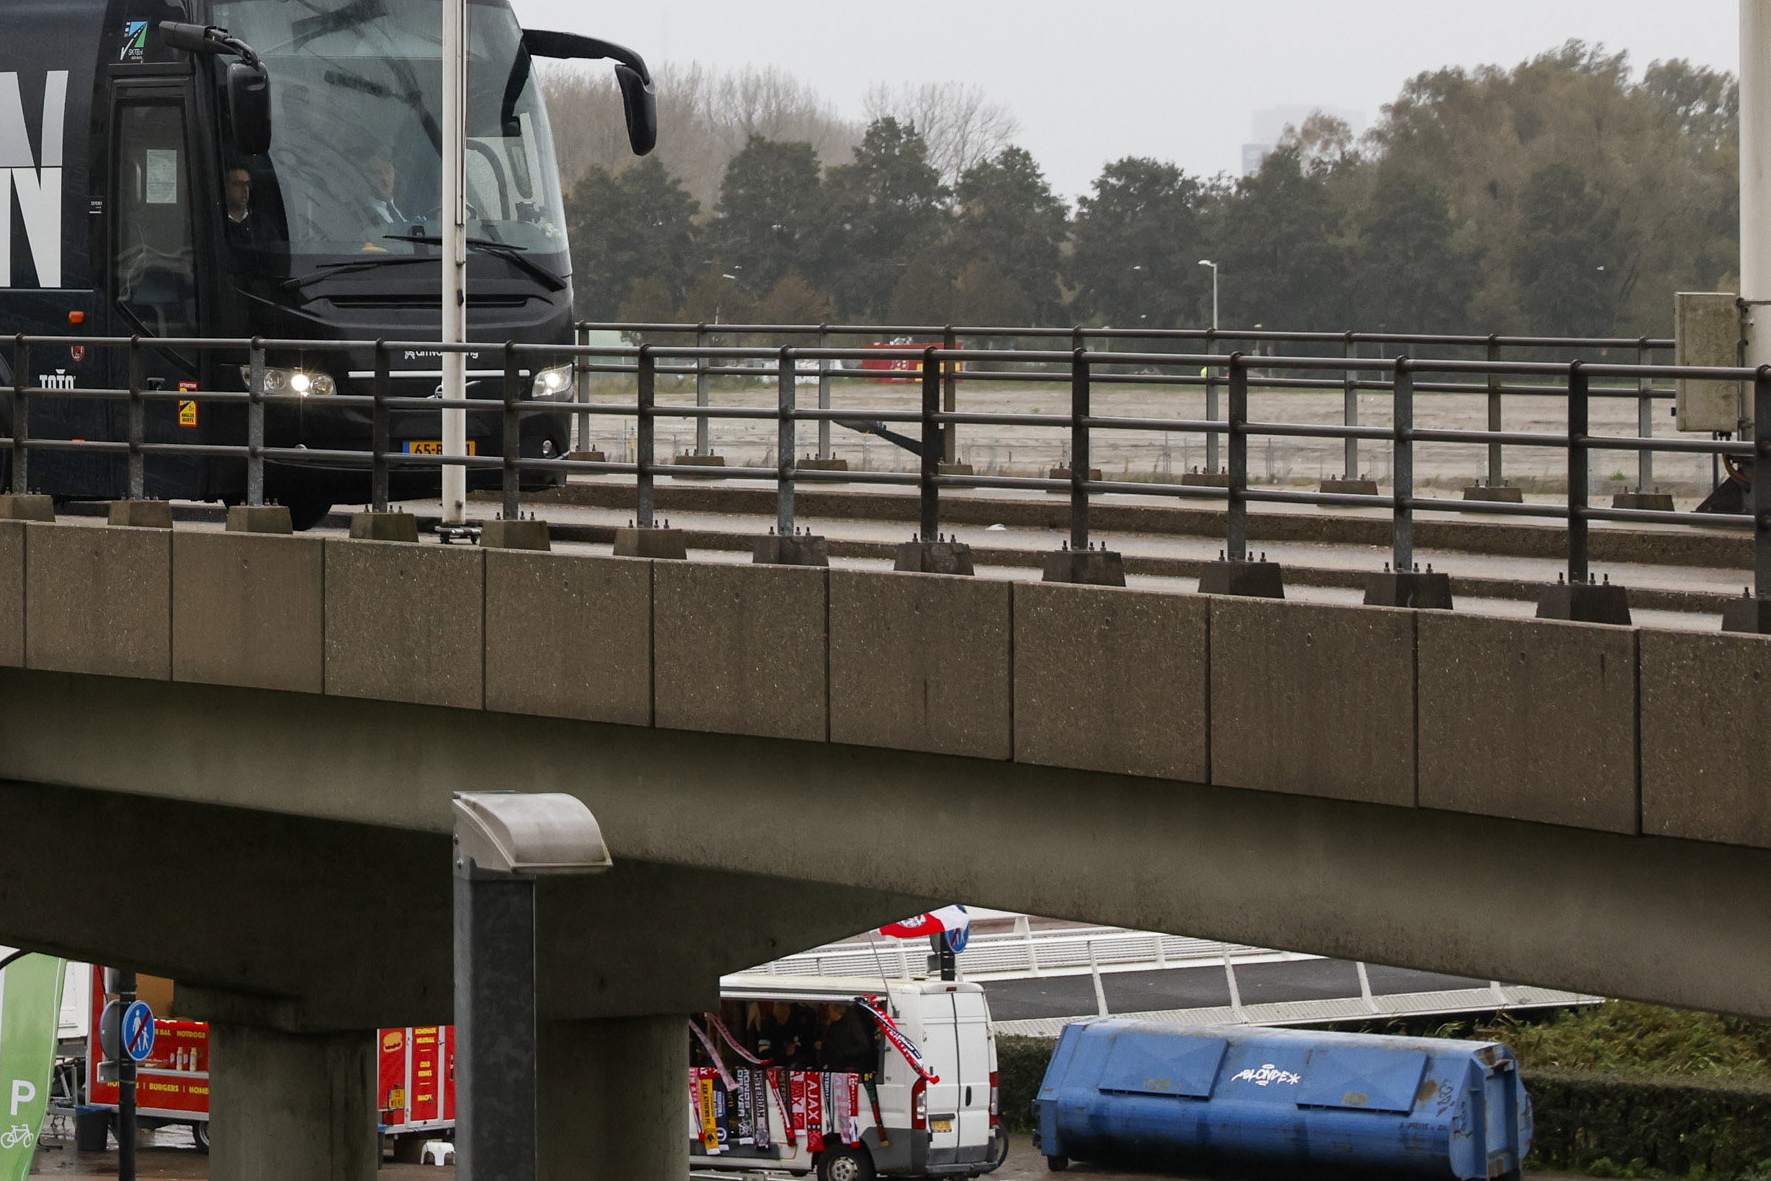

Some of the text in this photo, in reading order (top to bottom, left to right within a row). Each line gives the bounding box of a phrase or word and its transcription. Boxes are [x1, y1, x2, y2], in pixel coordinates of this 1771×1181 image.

[39, 373, 75, 389] TOTO
[10, 1079, 36, 1116] P
[149, 1083, 179, 1092] BURGERS
[806, 1079, 819, 1120] AJAX
